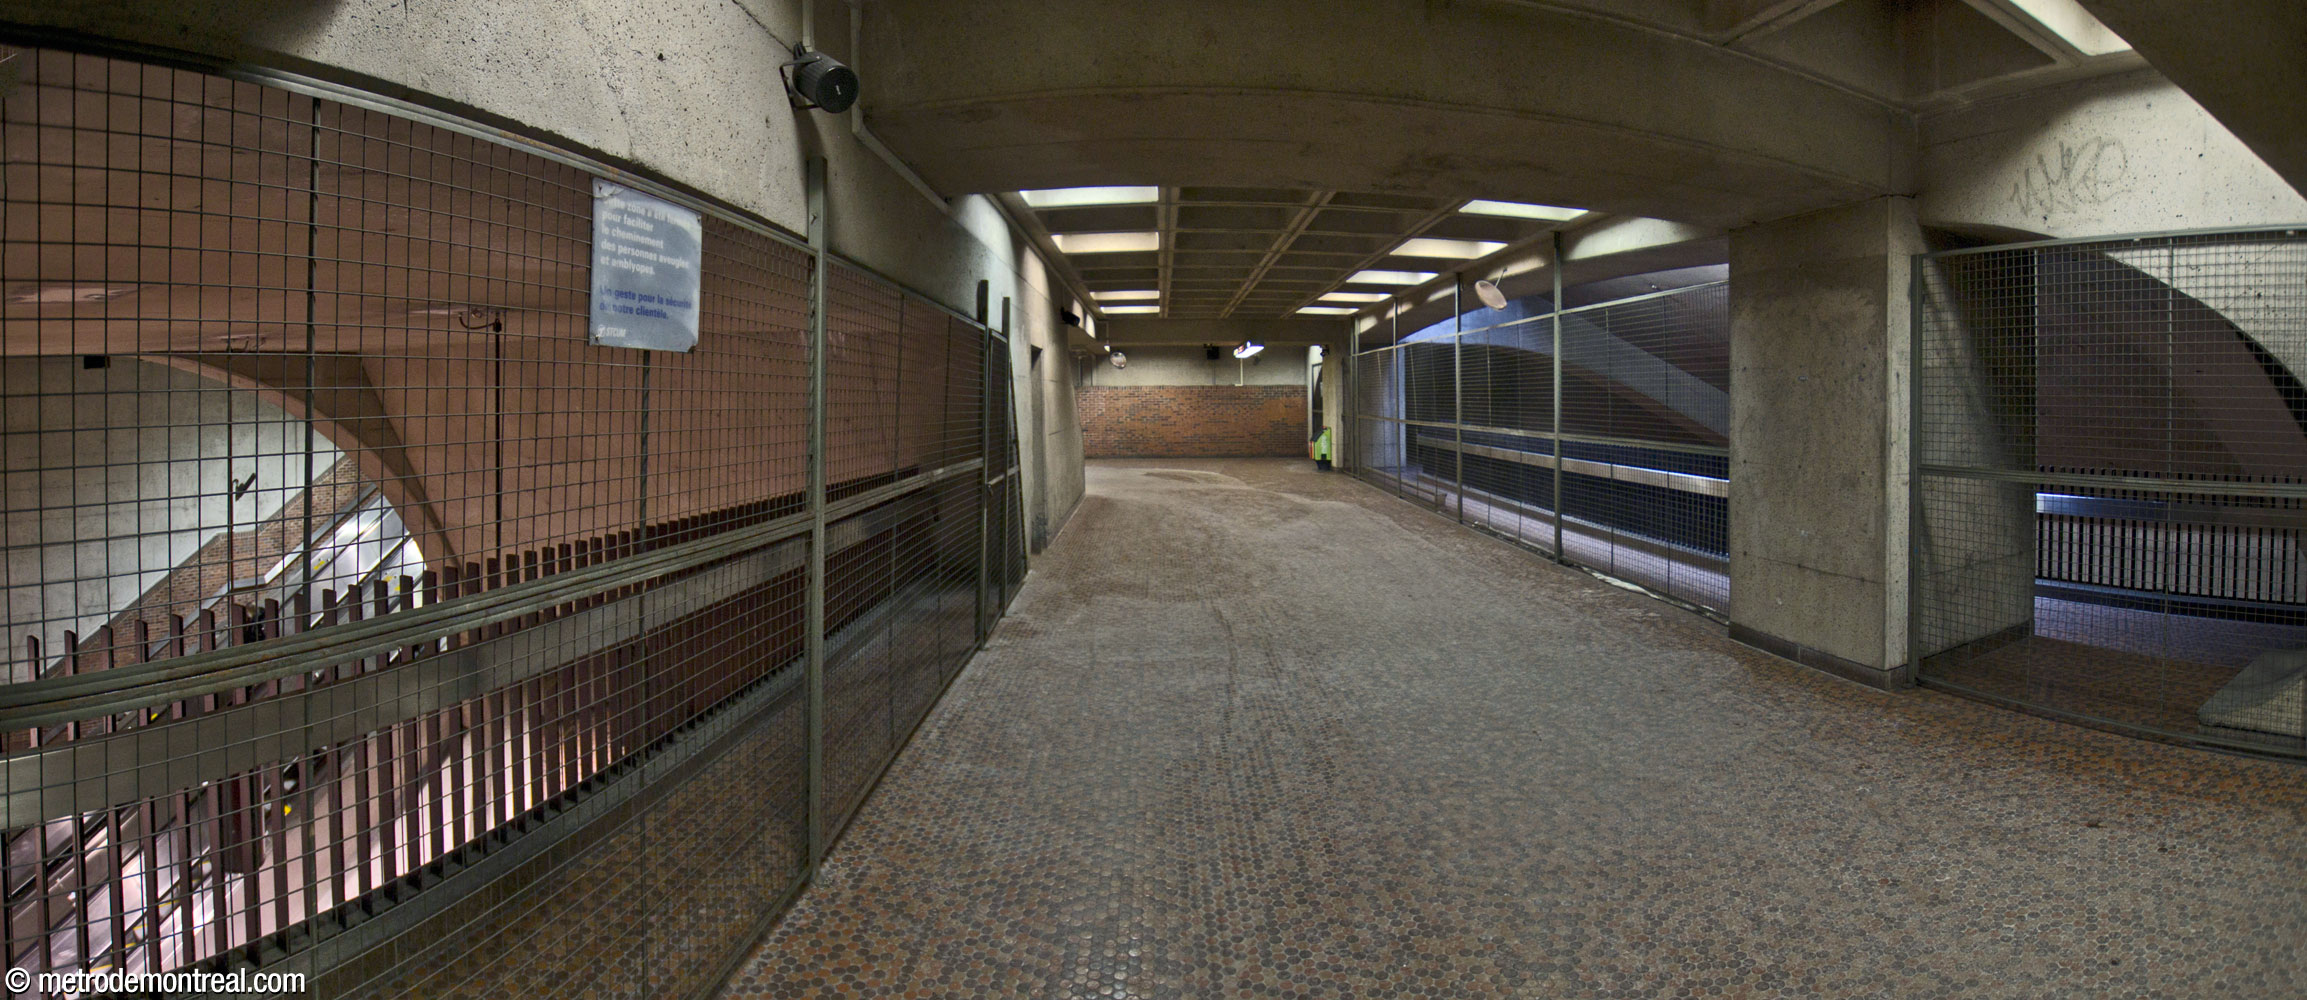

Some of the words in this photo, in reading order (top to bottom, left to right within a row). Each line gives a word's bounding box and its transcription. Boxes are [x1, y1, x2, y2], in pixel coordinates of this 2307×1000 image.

[627, 202, 646, 216] zone
[601, 211, 620, 223] pour
[624, 213, 654, 232] faciliter
[602, 225, 609, 235] le
[612, 227, 664, 249] cheminement
[600, 256, 609, 265] et
[601, 239, 616, 252] des
[618, 245, 657, 261] personnes
[659, 254, 689, 269] aveugles
[614, 289, 636, 300] geste
[638, 293, 655, 303] pour
[657, 294, 664, 305] la
[612, 303, 634, 315] notre
